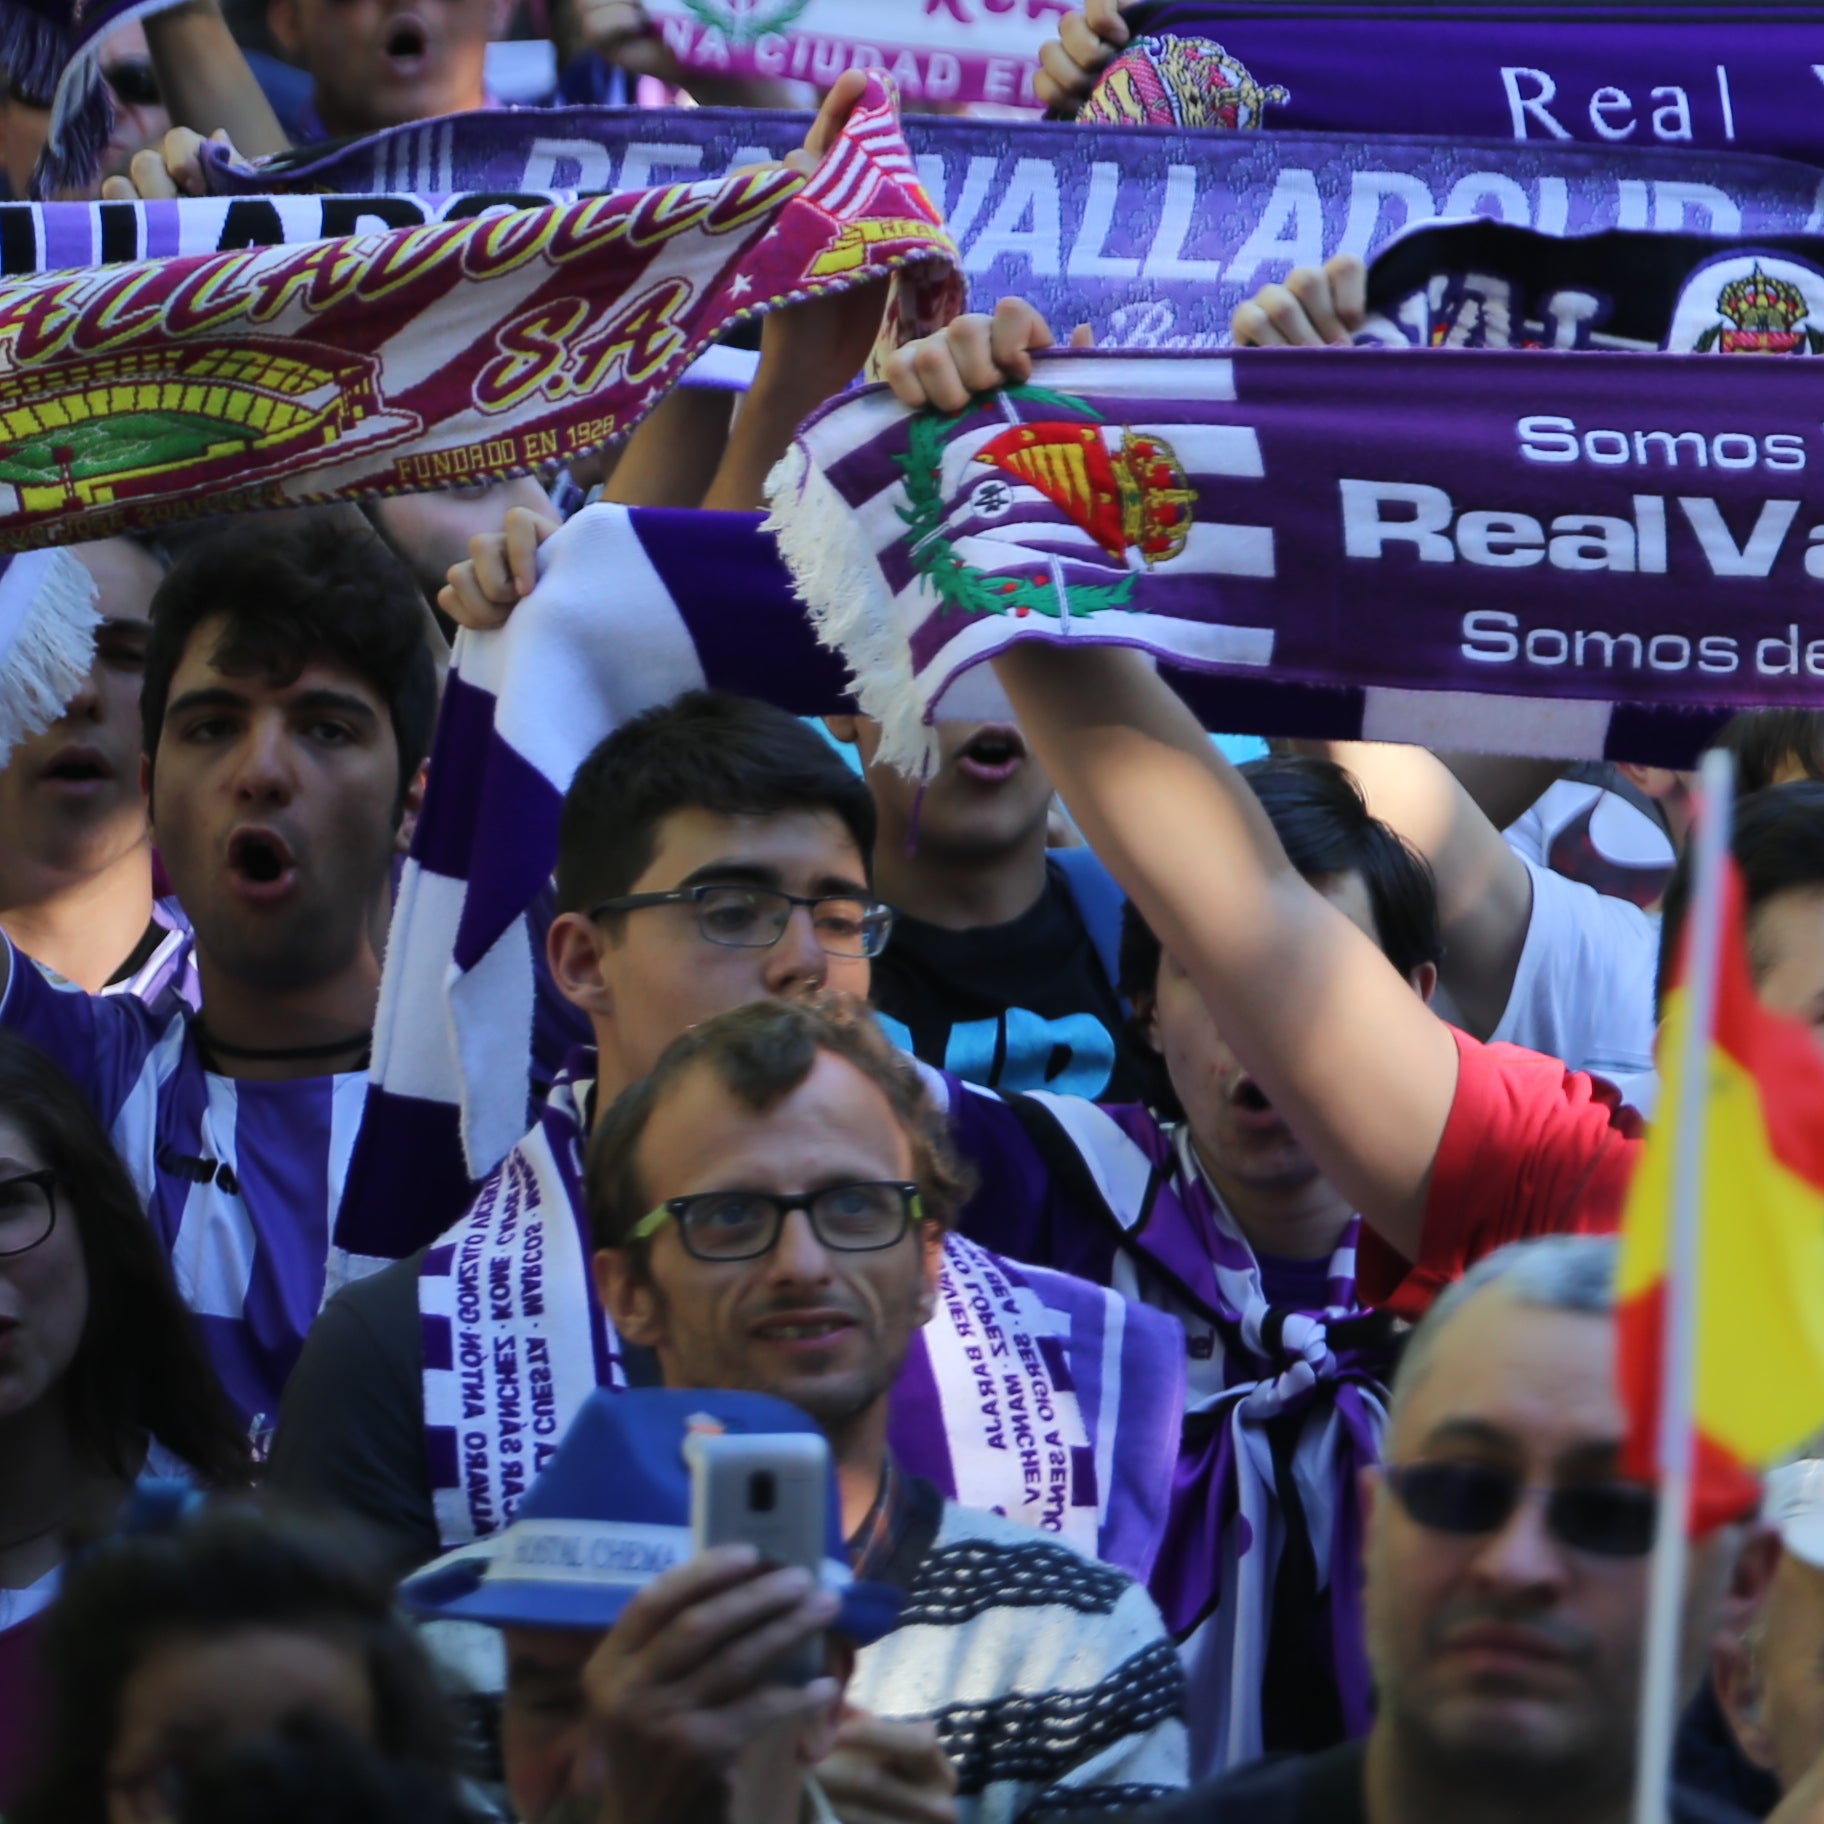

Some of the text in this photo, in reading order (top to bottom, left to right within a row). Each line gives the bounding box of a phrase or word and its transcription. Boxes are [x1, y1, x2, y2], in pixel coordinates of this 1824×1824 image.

[754, 32, 961, 98] CIUDAD
[1500, 64, 1735, 143] Real
[398, 413, 618, 482] FUNDADO EN 1928
[1514, 414, 1807, 475] Somos
[1460, 609, 1740, 673] Somos
